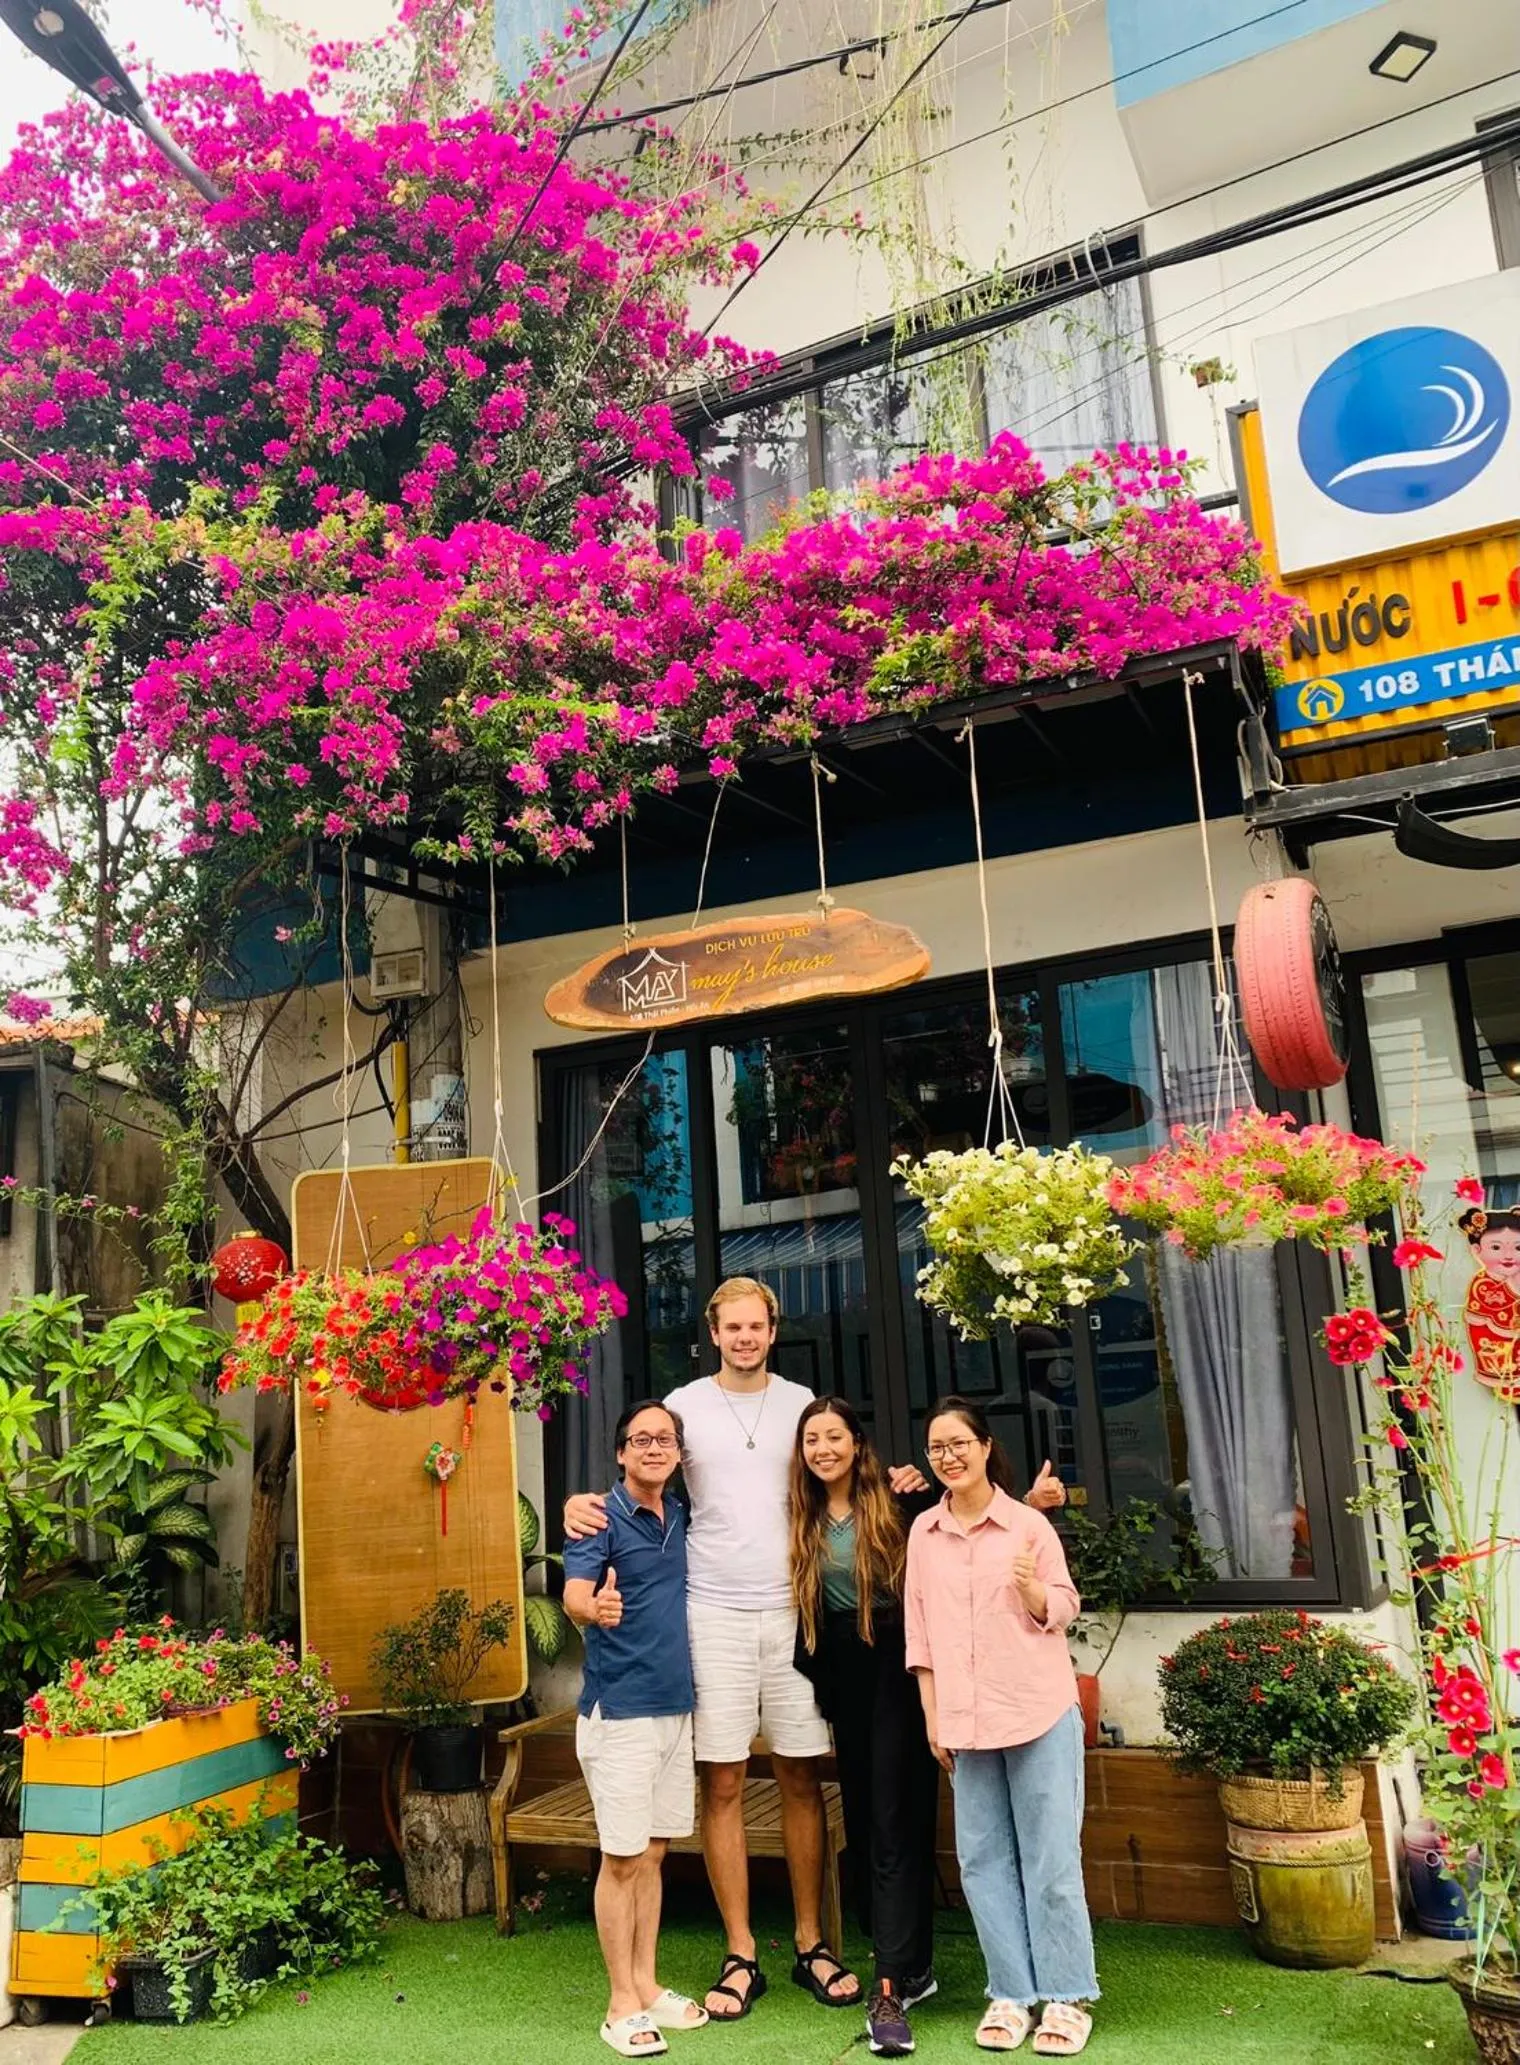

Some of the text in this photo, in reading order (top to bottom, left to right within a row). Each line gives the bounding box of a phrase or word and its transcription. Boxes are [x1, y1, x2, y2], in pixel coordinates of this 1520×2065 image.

[1290, 587, 1410, 662] NƯỚC
[1358, 671, 1420, 702] 108
[705, 939, 736, 955] DỊCH
[761, 943, 836, 980] house
